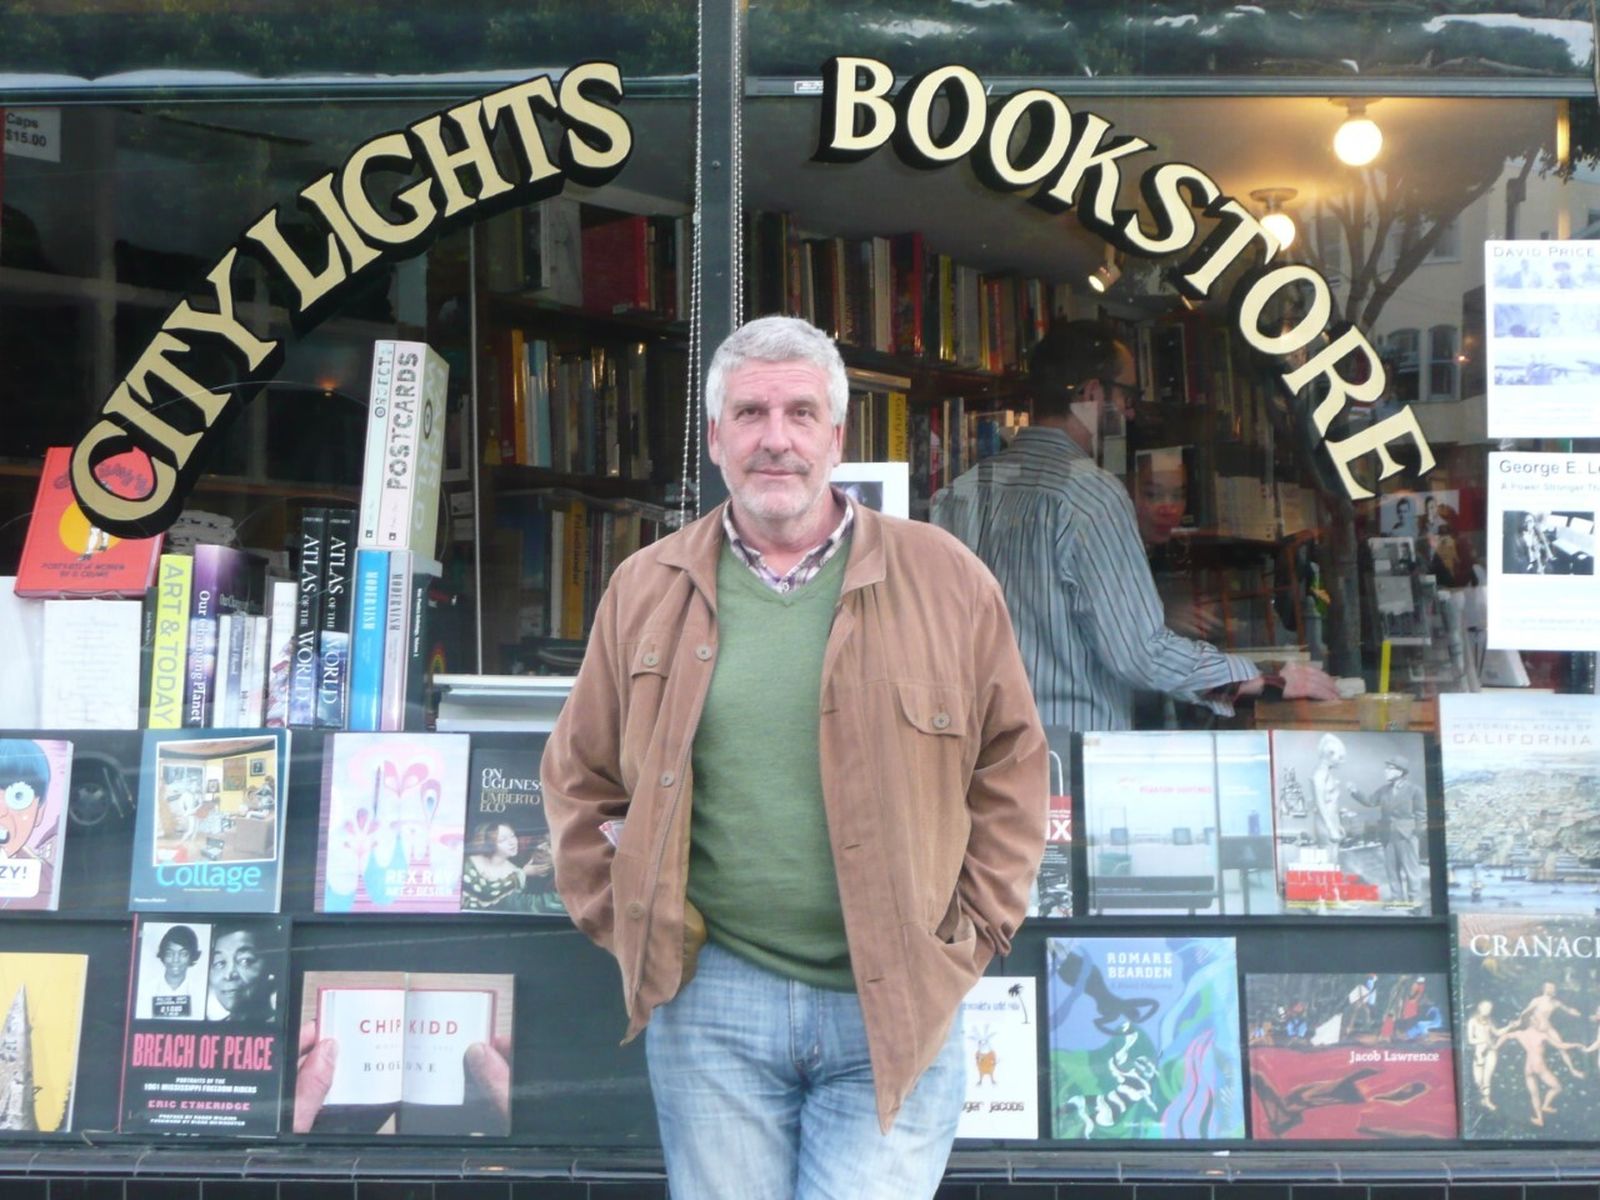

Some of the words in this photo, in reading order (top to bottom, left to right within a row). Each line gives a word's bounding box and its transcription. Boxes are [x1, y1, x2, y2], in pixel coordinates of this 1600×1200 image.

[6, 112, 39, 129] Caps
[6, 129, 47, 147] $15.00
[1493, 247, 1541, 257] DAVID
[1548, 247, 1594, 257] PRICE
[831, 56, 1436, 500] BOOKSTORE
[71, 247, 277, 523] CITY
[246, 62, 633, 312] LIGHTS
[386, 351, 419, 490] POSTCARDS
[1499, 459, 1560, 478] George
[302, 534, 320, 593] ATLAS
[328, 536, 347, 595] ATLAS
[161, 563, 184, 614] ART
[198, 590, 211, 616] Our
[362, 571, 379, 631] MODERNISM
[388, 574, 403, 632] MODERNISM
[160, 620, 181, 637] &
[295, 630, 315, 702] WORLD
[321, 636, 341, 705] WORLD
[153, 642, 179, 725] TODAY
[190, 680, 206, 721] Planet
[1453, 733, 1593, 746] CALIFORNIA
[482, 768, 503, 779] ON
[480, 802, 506, 813] ECO
[481, 791, 541, 805] UMBERTO
[156, 859, 262, 893] Collage
[1106, 951, 1173, 965] ROMARE
[1107, 966, 1173, 979] BEARDEN
[409, 1020, 458, 1035] KIDD
[131, 1032, 196, 1068] BREACH
[198, 1034, 221, 1070] OF
[222, 1035, 275, 1071] PEACE
[1348, 1050, 1382, 1065] Jacob
[1383, 1050, 1440, 1062] Lawrence
[148, 1099, 177, 1109] ERIC
[180, 1100, 250, 1111] ETHERIDGE
[989, 1101, 1025, 1113] jacobs
